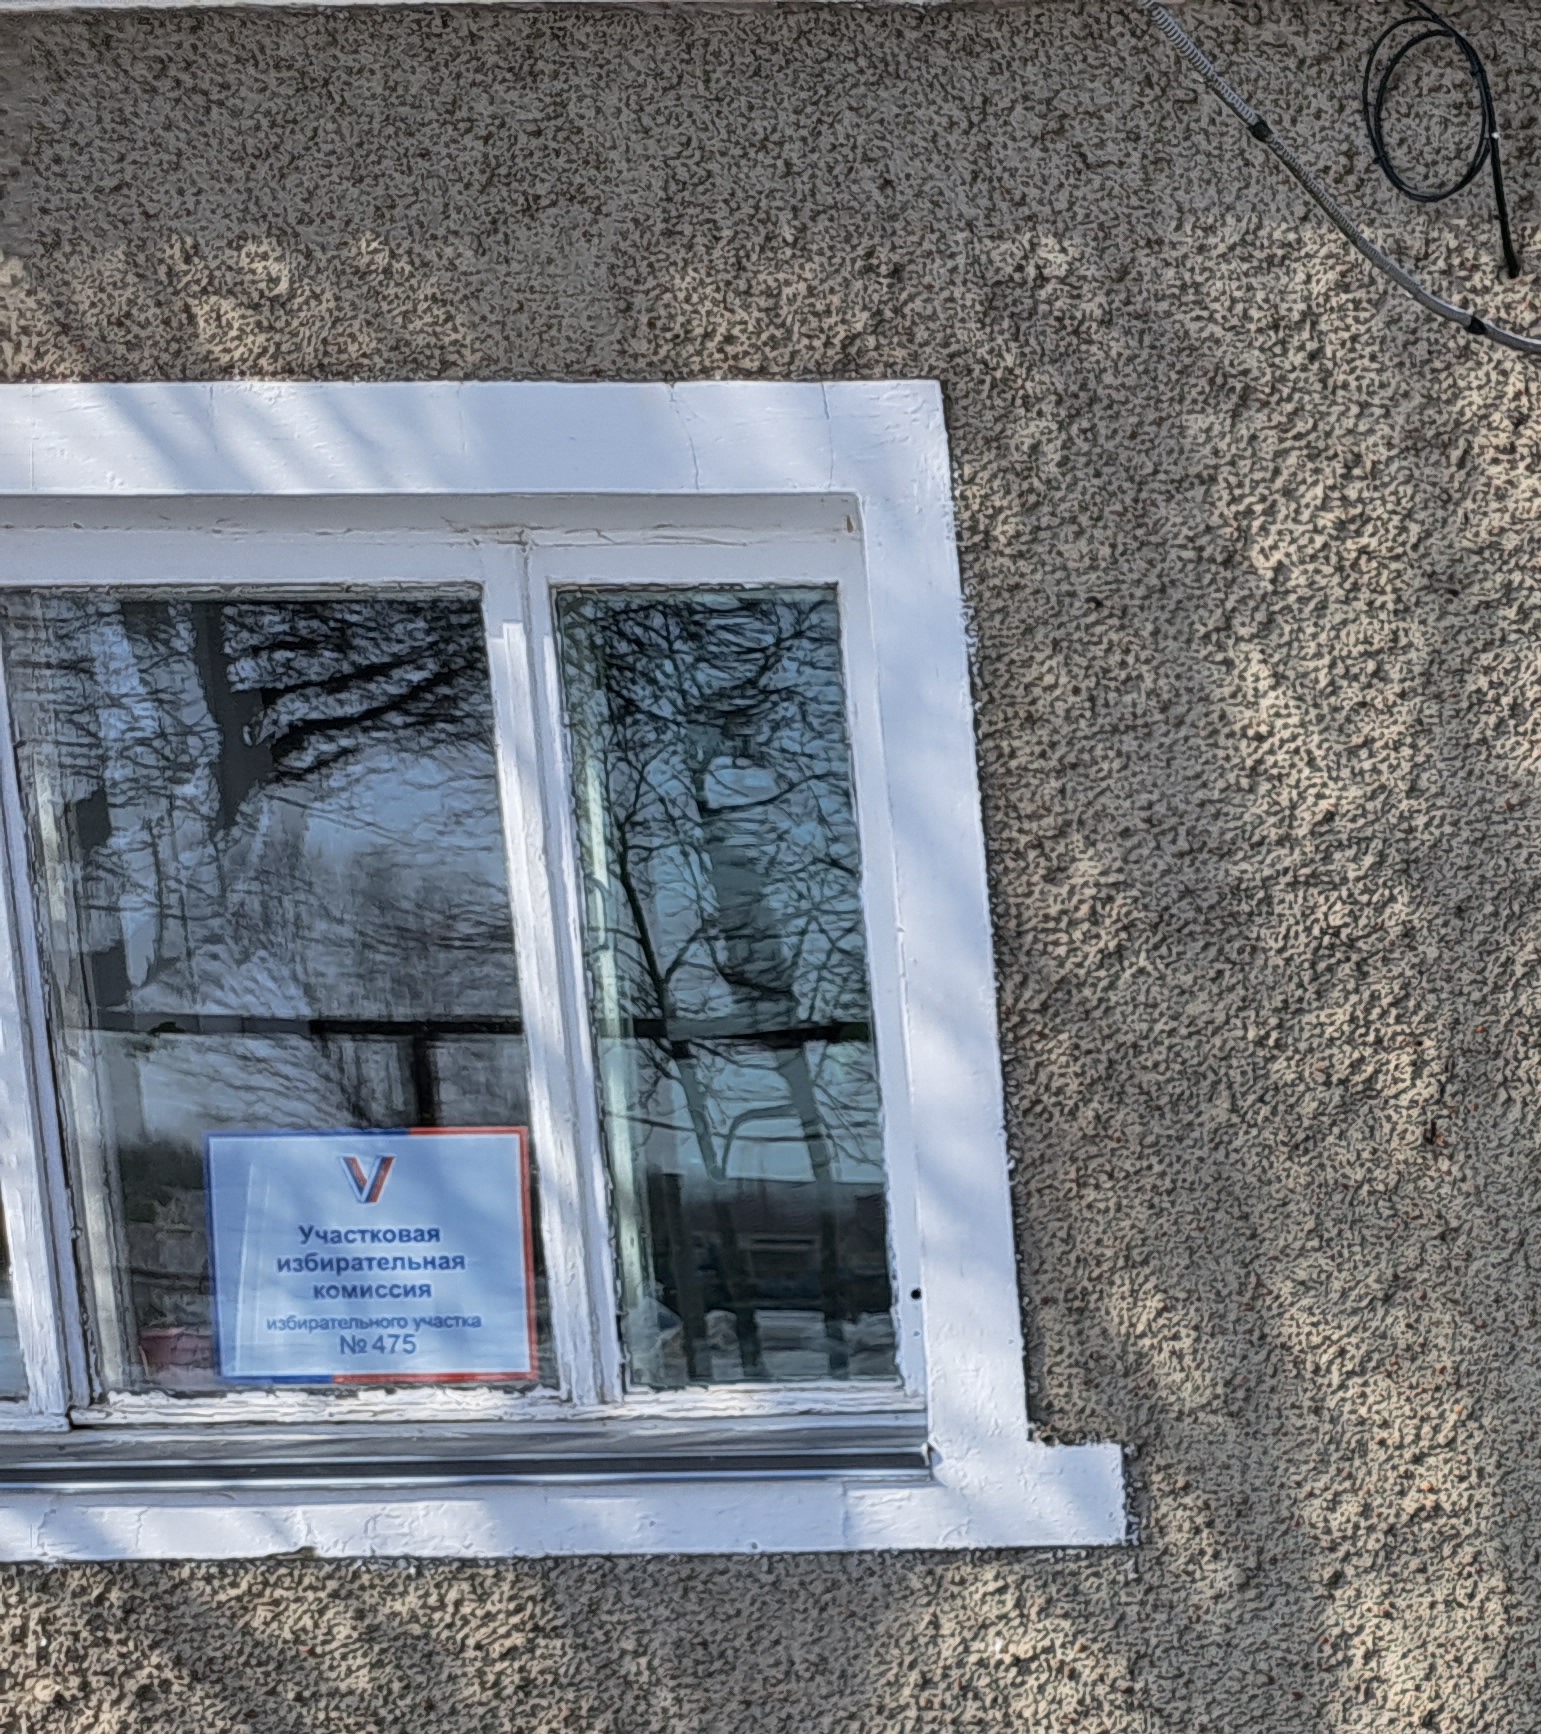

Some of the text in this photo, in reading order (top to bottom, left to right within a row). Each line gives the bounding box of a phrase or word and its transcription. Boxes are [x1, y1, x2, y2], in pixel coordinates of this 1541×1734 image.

[298, 1225, 441, 1246] Участковая
[277, 1254, 467, 1276] избирательная
[313, 1283, 433, 1300] комиссия
[266, 1314, 483, 1333] избирательного участка
[371, 1334, 418, 1354] 475
